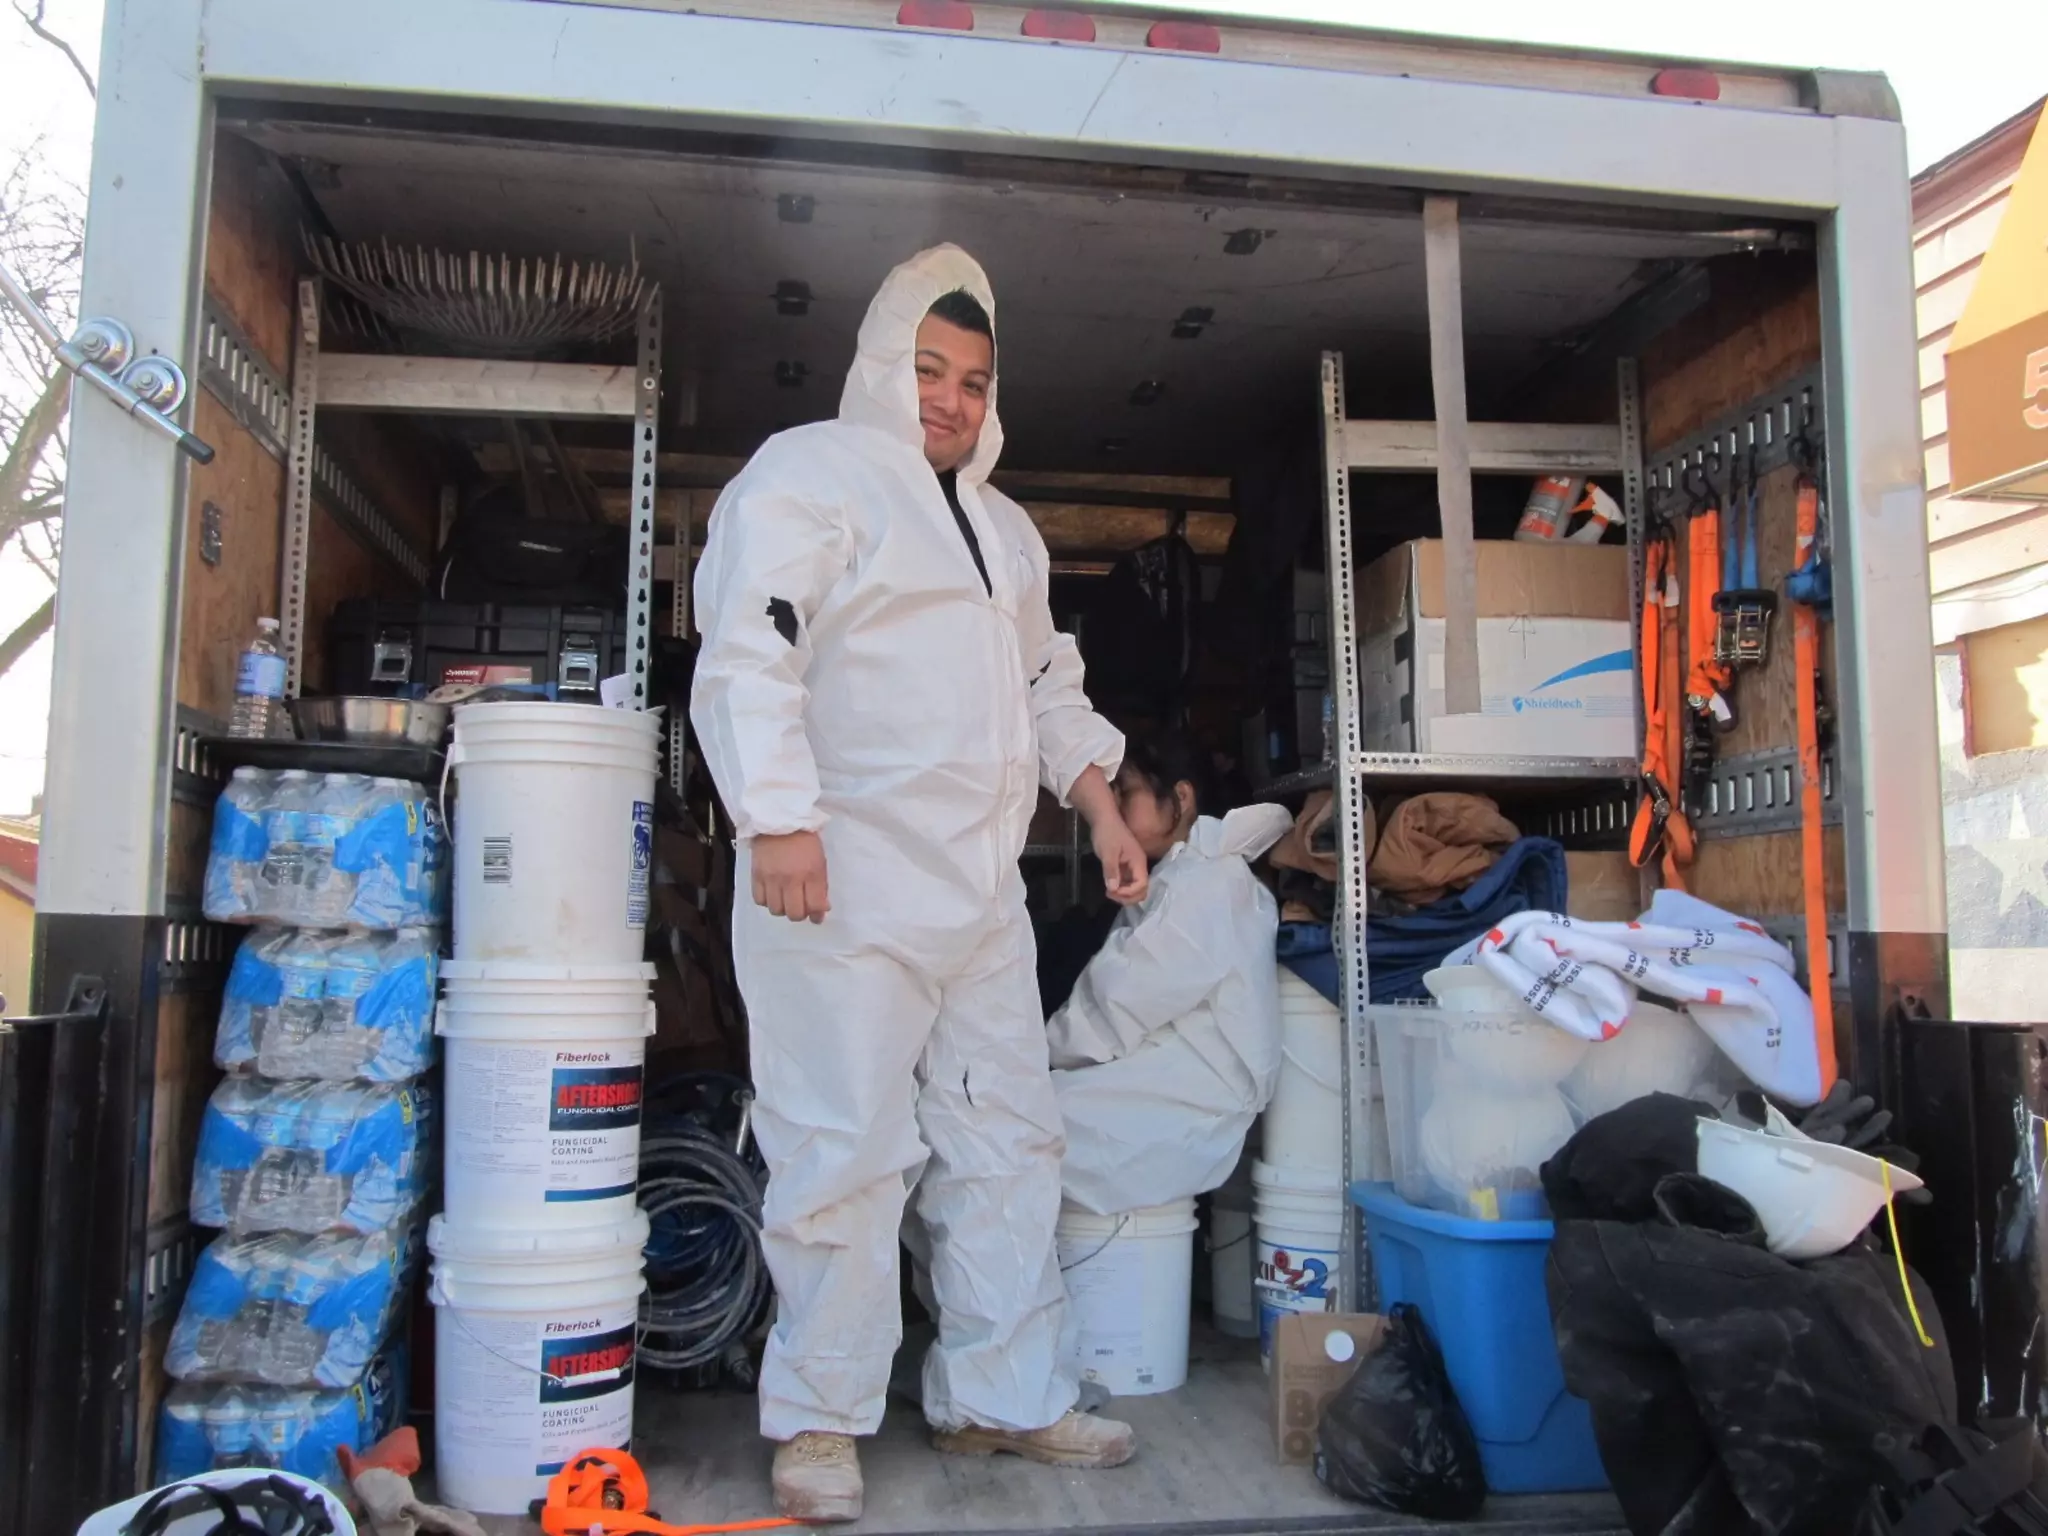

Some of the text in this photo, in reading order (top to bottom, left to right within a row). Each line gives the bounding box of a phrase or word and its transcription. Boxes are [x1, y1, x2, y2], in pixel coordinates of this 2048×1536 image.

[1524, 697, 1583, 709] Shieldtech
[556, 1052, 611, 1062] Fiberlock
[557, 1106, 614, 1115] FUNGICIDAL
[552, 1137, 608, 1146] FUNGICIDAL
[551, 1147, 594, 1156] COATING
[1302, 1257, 1329, 1298] 2
[545, 1318, 601, 1332] Fiberlock
[543, 1404, 599, 1418] FUNGICIDAL
[542, 1416, 585, 1428] COATING
